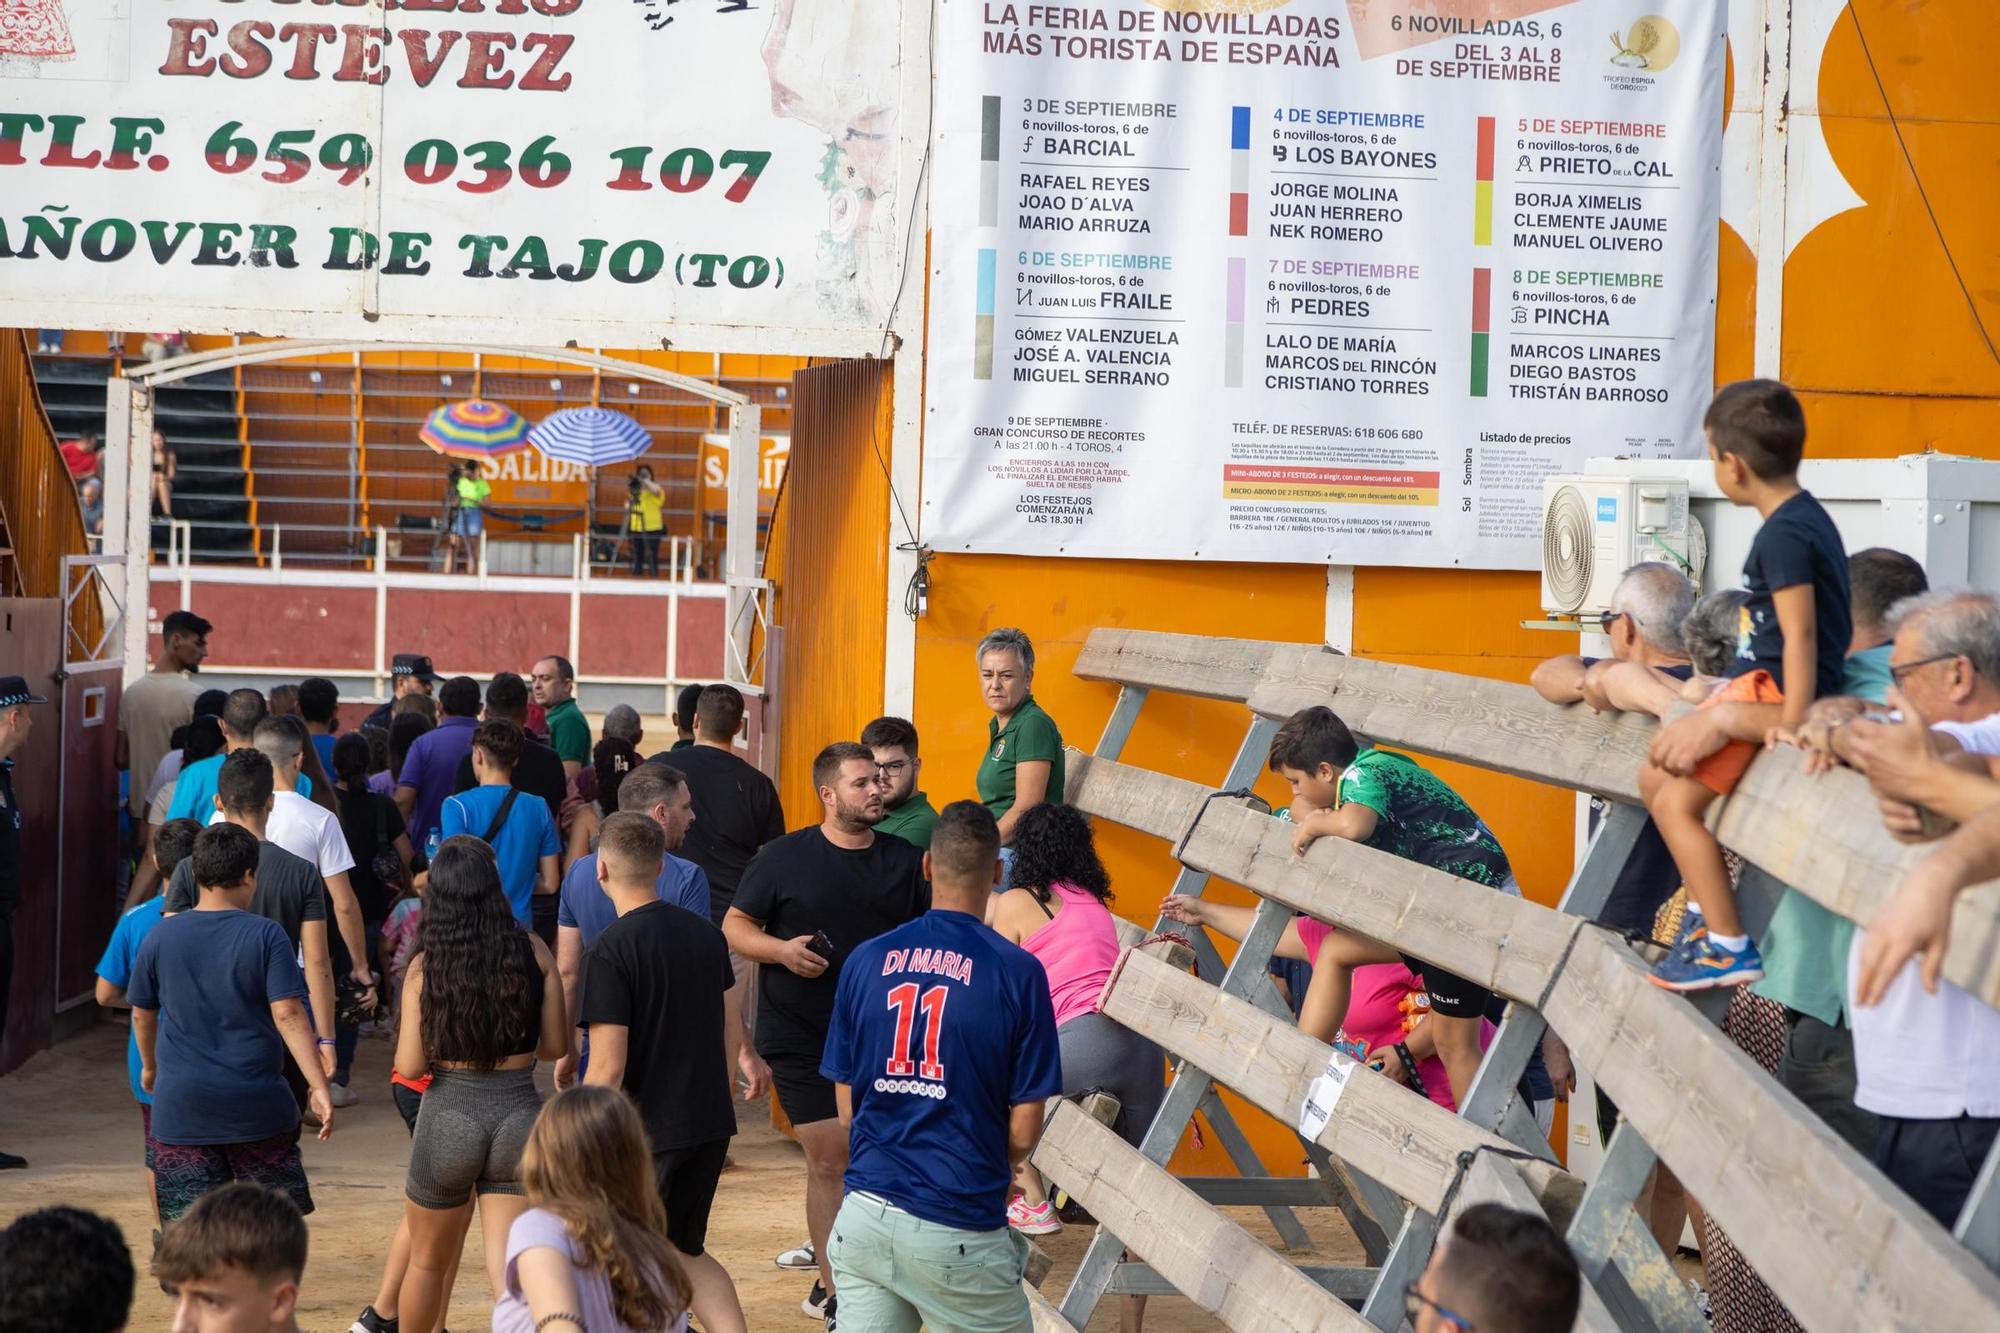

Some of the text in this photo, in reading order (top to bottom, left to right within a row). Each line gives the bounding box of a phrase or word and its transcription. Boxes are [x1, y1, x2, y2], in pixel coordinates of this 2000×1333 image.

[984, 3, 1340, 39] LA FERIA DE NOVILLADAS
[1391, 15, 1562, 41] 6 NOVILLADAS, 6
[158, 17, 575, 92] ESTEVEZ
[984, 31, 1340, 68] MÁS TORISTA DE ESPAÑA
[1455, 43, 1561, 64] DEL 3 AL 8
[1396, 59, 1560, 82] DE SEPTIEMBRE
[1023, 98, 1176, 118] 3 DE SEPTIEMBRE
[1022, 119, 1149, 135] 6 novillos-toros, 6 de
[1274, 108, 1424, 128] 4 DE SEPTIEMBRE
[1273, 129, 1397, 145] 6 novillos-toros, 6 de
[1518, 119, 1666, 138] 5 DE SEPTIEMBRE
[1044, 138, 1135, 156] BARCIAL
[1517, 139, 1639, 154] 6 novillos-toros, 6 de
[0, 113, 772, 203] TLF. 659 036 107
[1296, 146, 1437, 169] LOS BAYONES
[1540, 157, 1611, 175] PRIETO
[1634, 160, 1673, 177] CAL
[1021, 173, 1150, 192] RAFAEL REYES
[1019, 194, 1066, 210] JOAO
[1270, 183, 1398, 202] JORGE MOLINA
[1515, 193, 1642, 211] BORJA XIMELIS
[1270, 203, 1402, 222] JUAN HERRERO
[1019, 215, 1151, 233] MARIO ARRUZA
[1514, 213, 1667, 232] CLEMENTE JAUME
[1270, 224, 1383, 242] NEK ROMERO
[1514, 234, 1663, 252] MANUEL OLIVERO
[321, 227, 432, 276] DE
[457, 234, 664, 284] TAJO
[675, 252, 785, 289] (TO)
[1018, 251, 1172, 270] 6 DE SEPTIEMBRE
[1269, 259, 1419, 279] 7 DE SEPTIEMBRE
[1018, 272, 1144, 287] 6 novillos-toros, 6 de
[1268, 280, 1391, 296] 6 novillos-toros, 6 de
[1513, 270, 1663, 288] 8 DE SEPTIEMBRE
[1038, 292, 1172, 310] JUAN LUIS FRAILE
[1512, 290, 1636, 305] 6 novillos-toros, 6 de
[1291, 298, 1370, 317] PEDRES
[1535, 308, 1610, 326] PINCHA
[1015, 327, 1179, 345] GÓMEZ VALENZUELA
[1266, 334, 1396, 353] LALO DE MARÍA
[1014, 346, 1171, 365] JOSÉ A. VALENCIA
[1511, 344, 1661, 362] MARCOS LINARES
[1266, 355, 1436, 375] MARCOS DEL RINCÓN
[1510, 364, 1636, 382] DIEGO BASTOS
[1014, 367, 1169, 386] MIGUEL SERRANO
[1265, 375, 1429, 395] CRISTIANO TORRES
[1509, 384, 1668, 403] TRISTÁN BARROSO
[1008, 416, 1102, 428] 9 DE SEPTIEMBRE
[1232, 421, 1423, 440] TELÉF. DE RESERVAS: 618 606 680
[974, 426, 1145, 441] GRAN CONCURSO DE RECORTES
[1480, 432, 1571, 446] Listado de precios
[994, 440, 1122, 453] A las 21.00 h 4 TOROS, 4
[481, 449, 588, 482] SALIDA
[1463, 448, 1473, 486] Sombra
[1462, 497, 1472, 512] Sol
[882, 948, 973, 986] DI MARIA
[886, 982, 949, 1081] 11
